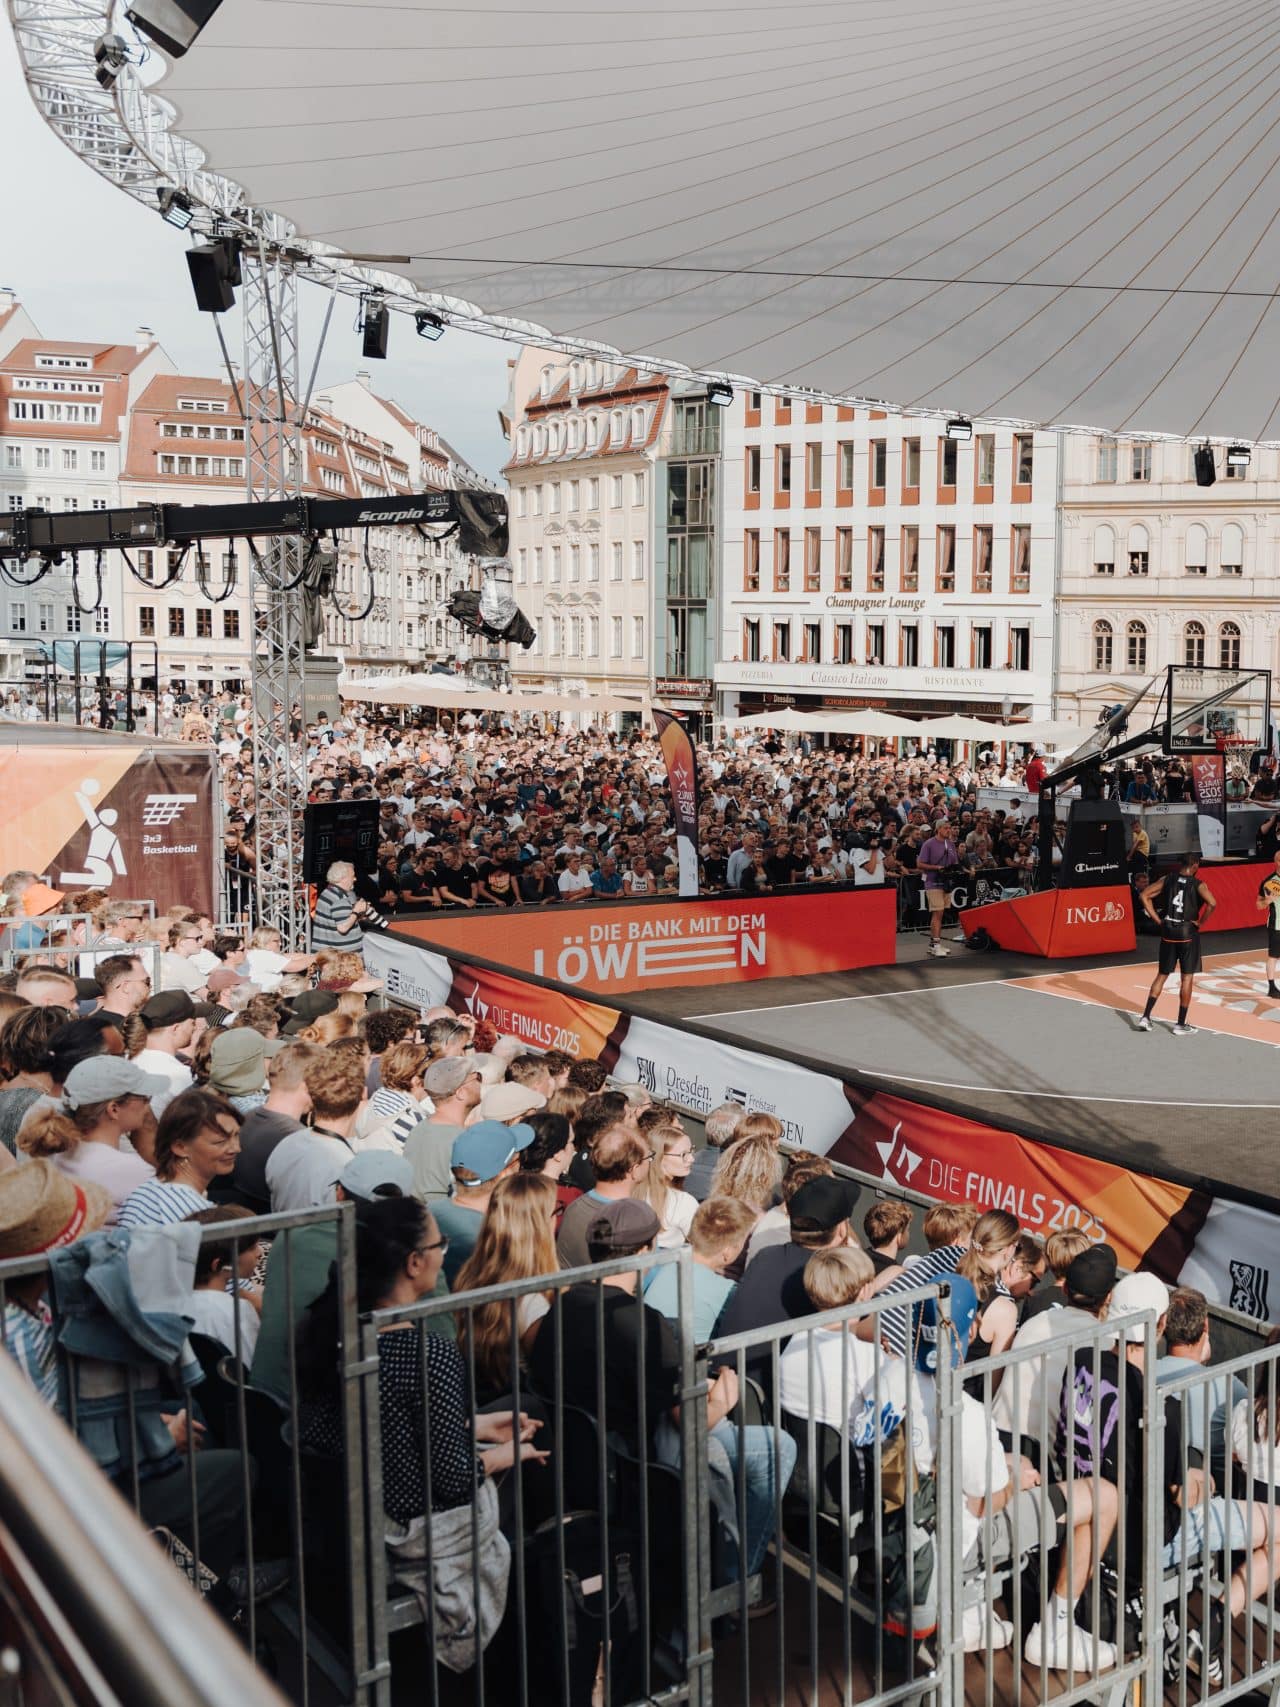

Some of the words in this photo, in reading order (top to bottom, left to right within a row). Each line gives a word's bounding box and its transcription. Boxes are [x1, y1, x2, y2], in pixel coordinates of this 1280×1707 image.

[357, 508, 424, 522] Scorpio
[825, 596, 886, 611] Champagner
[888, 596, 926, 612] Lounge
[741, 671, 773, 680] PIZZERIA
[811, 671, 848, 683] Classico
[850, 672, 888, 686] Italiano
[925, 677, 984, 688] RISTORANTE
[143, 834, 162, 843] 3x3
[143, 845, 198, 855] Basketball
[1075, 863, 1119, 874] Champion
[918, 887, 968, 911] IG
[1172, 889, 1184, 913] 4
[1066, 906, 1100, 924] ING
[590, 923, 622, 942] DIE
[628, 919, 684, 939] BANK
[689, 916, 723, 934] MIT
[727, 913, 766, 931] DEM
[492, 1006, 511, 1030] DIE
[511, 1012, 552, 1046] FINALS
[552, 1026, 581, 1056] 2025
[666, 1066, 713, 1102] Dresden.
[749, 1094, 777, 1114] Freistaat
[928, 1159, 962, 1196] DIE
[965, 1172, 1047, 1225] FINALS
[1047, 1199, 1108, 1244] 2025
